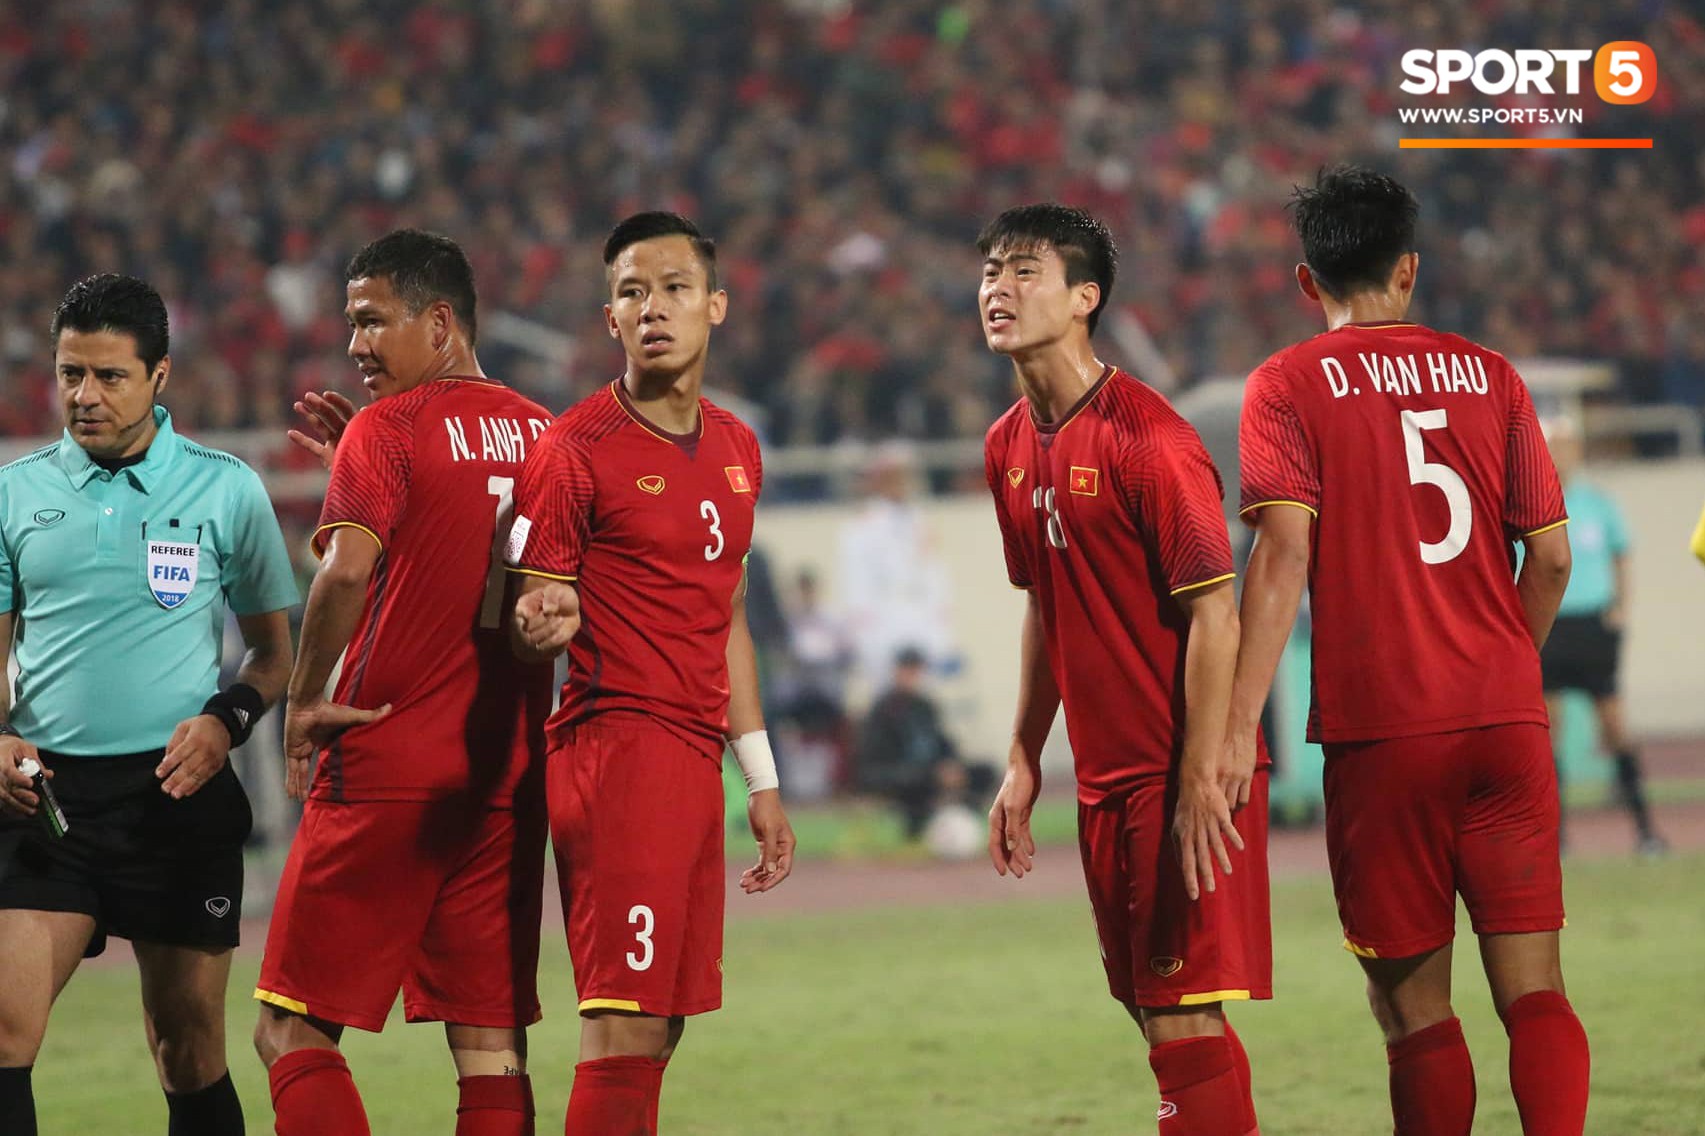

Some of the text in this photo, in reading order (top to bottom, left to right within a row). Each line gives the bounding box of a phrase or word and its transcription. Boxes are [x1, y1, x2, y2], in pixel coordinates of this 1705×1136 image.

[1320, 352, 1488, 398] D. VAN HAU
[444, 416, 477, 462] N.
[479, 416, 525, 463] ANH
[1401, 408, 1472, 564] 5
[151, 545, 195, 557] REFEREE
[700, 500, 724, 562] 3
[153, 565, 190, 581] FIFA
[161, 594, 180, 602] 2018
[626, 905, 655, 972] 3
